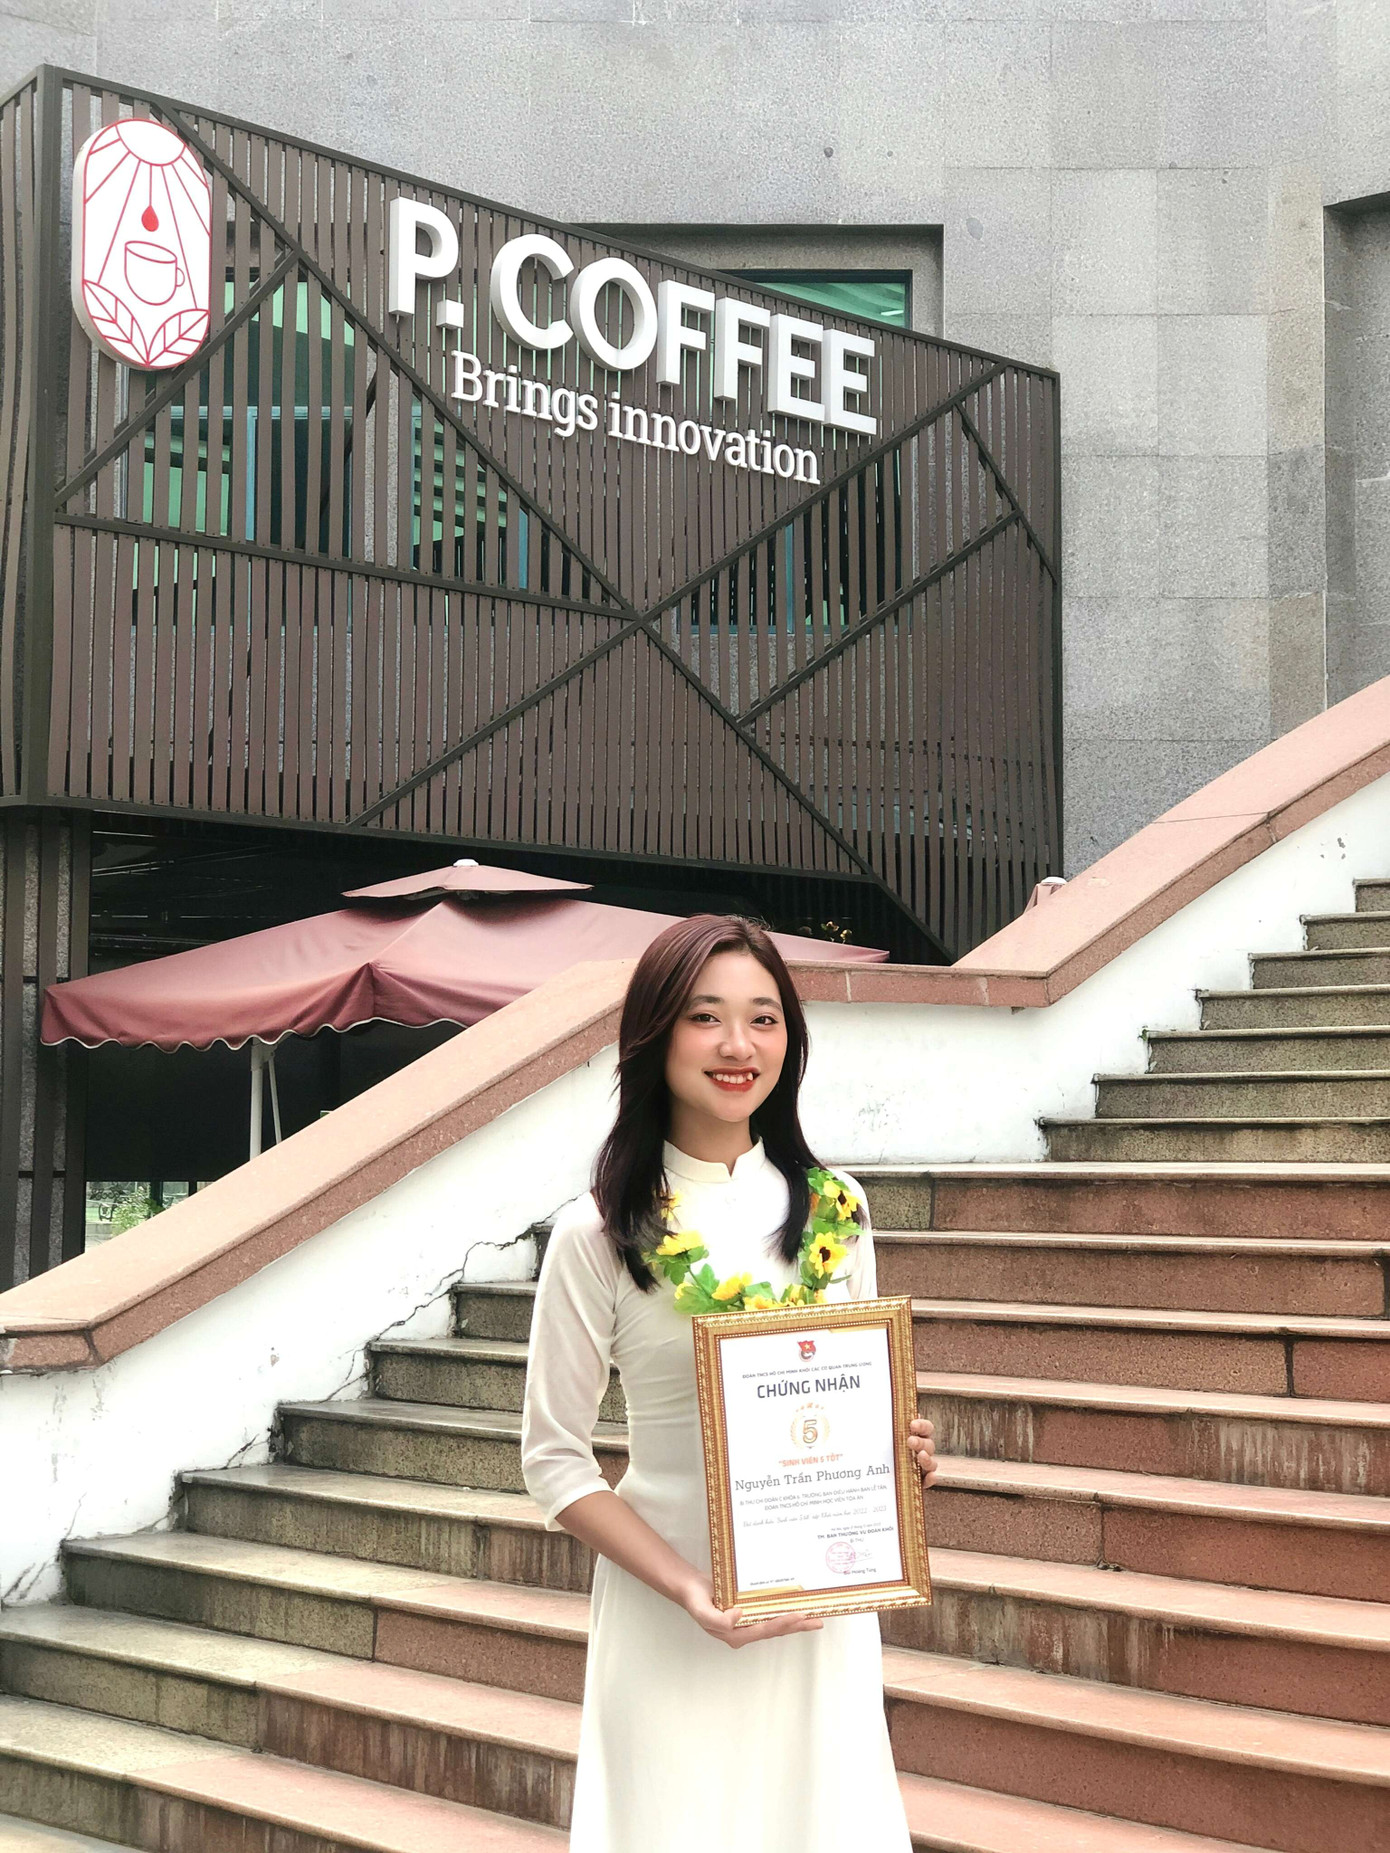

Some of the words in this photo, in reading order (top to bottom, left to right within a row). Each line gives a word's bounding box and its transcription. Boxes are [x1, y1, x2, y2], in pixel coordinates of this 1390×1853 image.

[491, 233, 877, 436] COFFEE
[451, 350, 600, 438] Brings
[608, 391, 821, 486] innovation
[757, 1379, 811, 1399] CHỨNG
[815, 1373, 861, 1393] NHẬN
[802, 1419, 818, 1444] 5
[735, 1474, 781, 1493] Nguyễn
[783, 1471, 812, 1485] Trần
[816, 1467, 862, 1482] Phương
[866, 1463, 891, 1476] Anh
